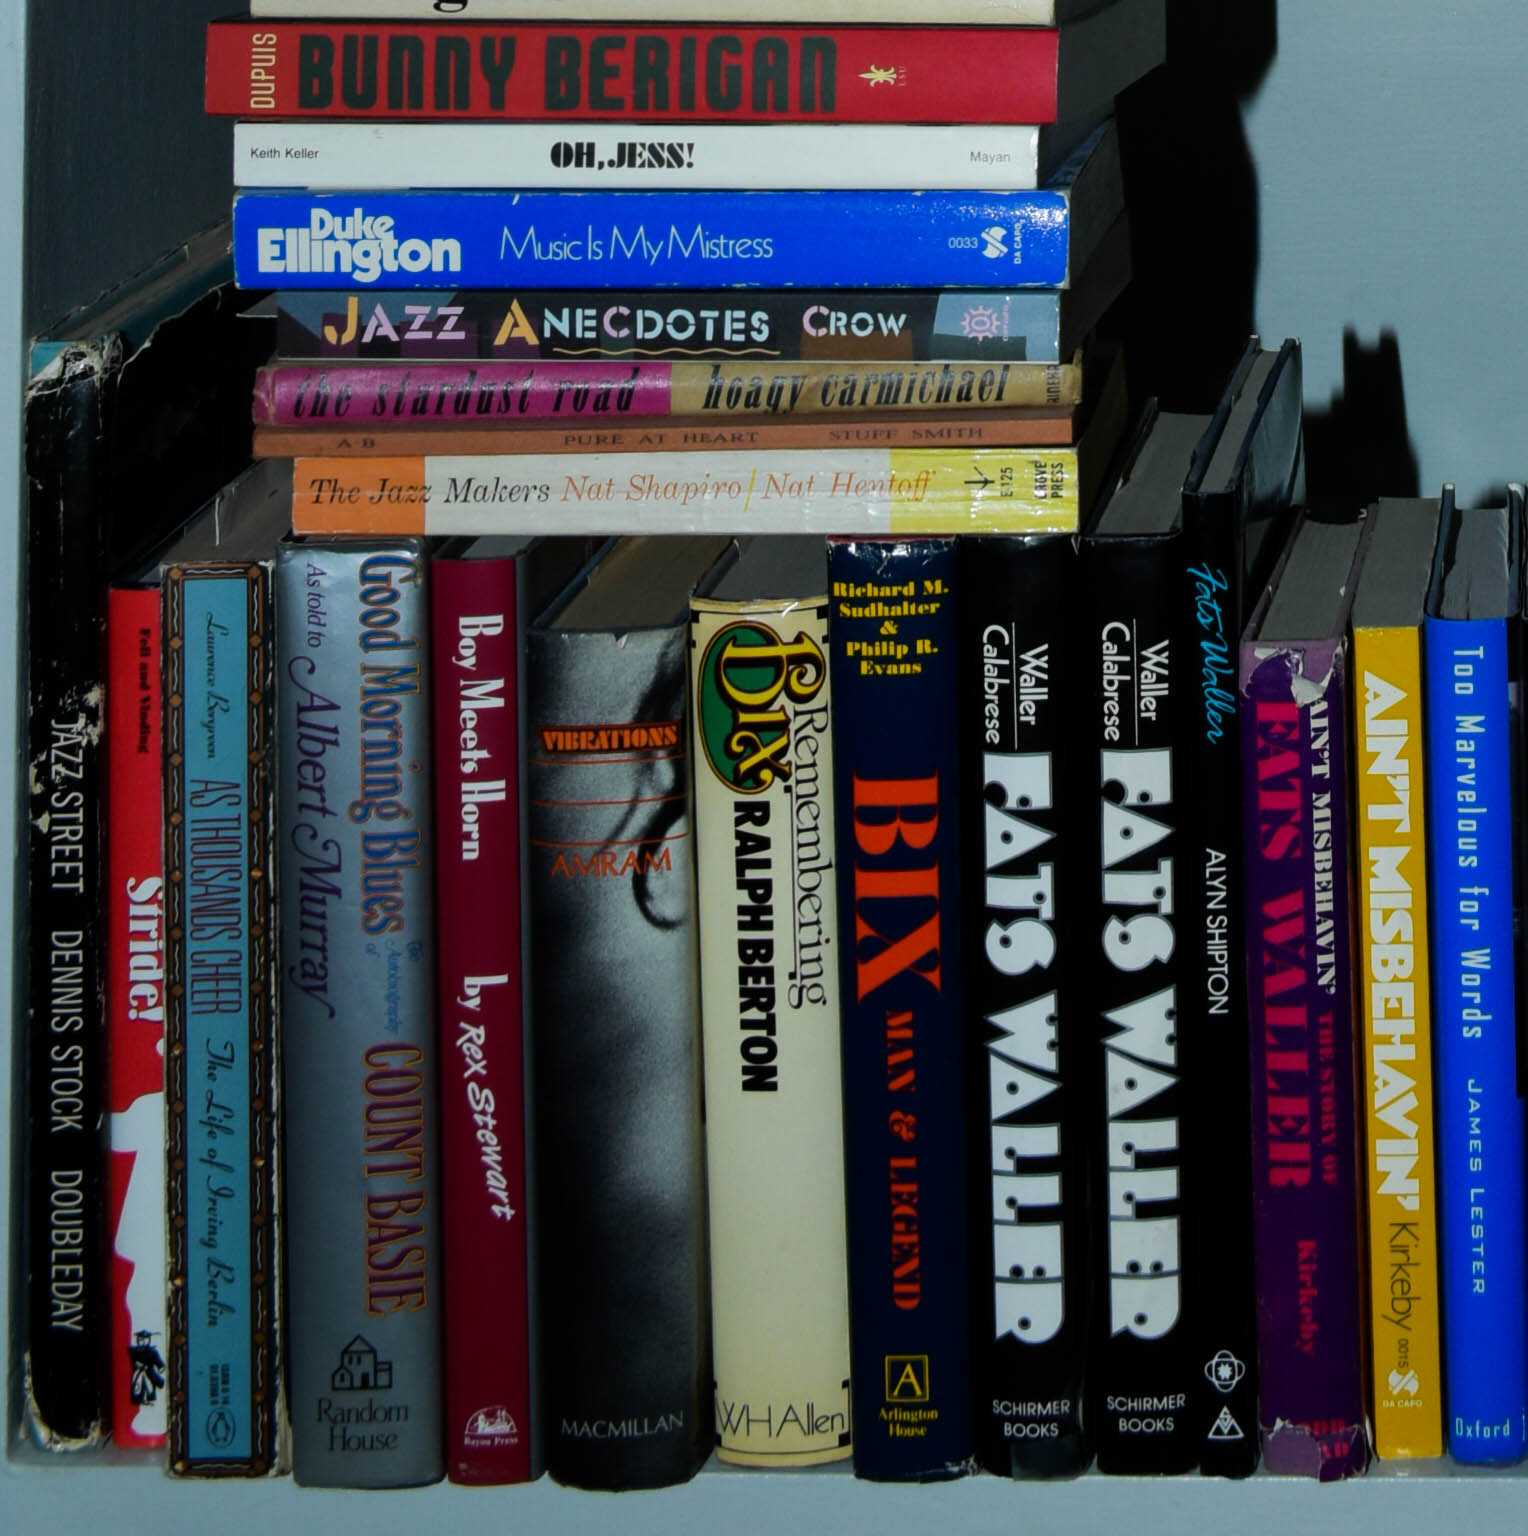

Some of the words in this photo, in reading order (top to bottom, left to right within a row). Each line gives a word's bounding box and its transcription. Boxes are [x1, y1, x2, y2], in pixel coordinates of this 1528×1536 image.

[298, 33, 516, 110] BUNNY
[544, 34, 837, 113] BERIGAN
[250, 147, 282, 159] Keith
[285, 147, 319, 159] Keller
[501, 225, 583, 262] Music
[588, 225, 603, 259] Is
[609, 225, 658, 267] My
[668, 225, 773, 260] Mistress
[803, 305, 907, 338] CROW
[453, 613, 504, 672] Boy
[459, 678, 505, 775] Meets
[543, 724, 678, 753] VIBRATIONS
[461, 779, 507, 861] Horn
[551, 848, 671, 878] AMRAM
[1204, 847, 1227, 910] ALYN
[51, 929, 84, 1033] DENNIS
[1206, 914, 1229, 1014] SHIPTON
[51, 1044, 83, 1133] STOCK
[51, 1170, 83, 1331] DOUBLEDAY
[992, 1398, 1072, 1417] SCHIRMER
[1003, 1421, 1060, 1438] BOOKS
